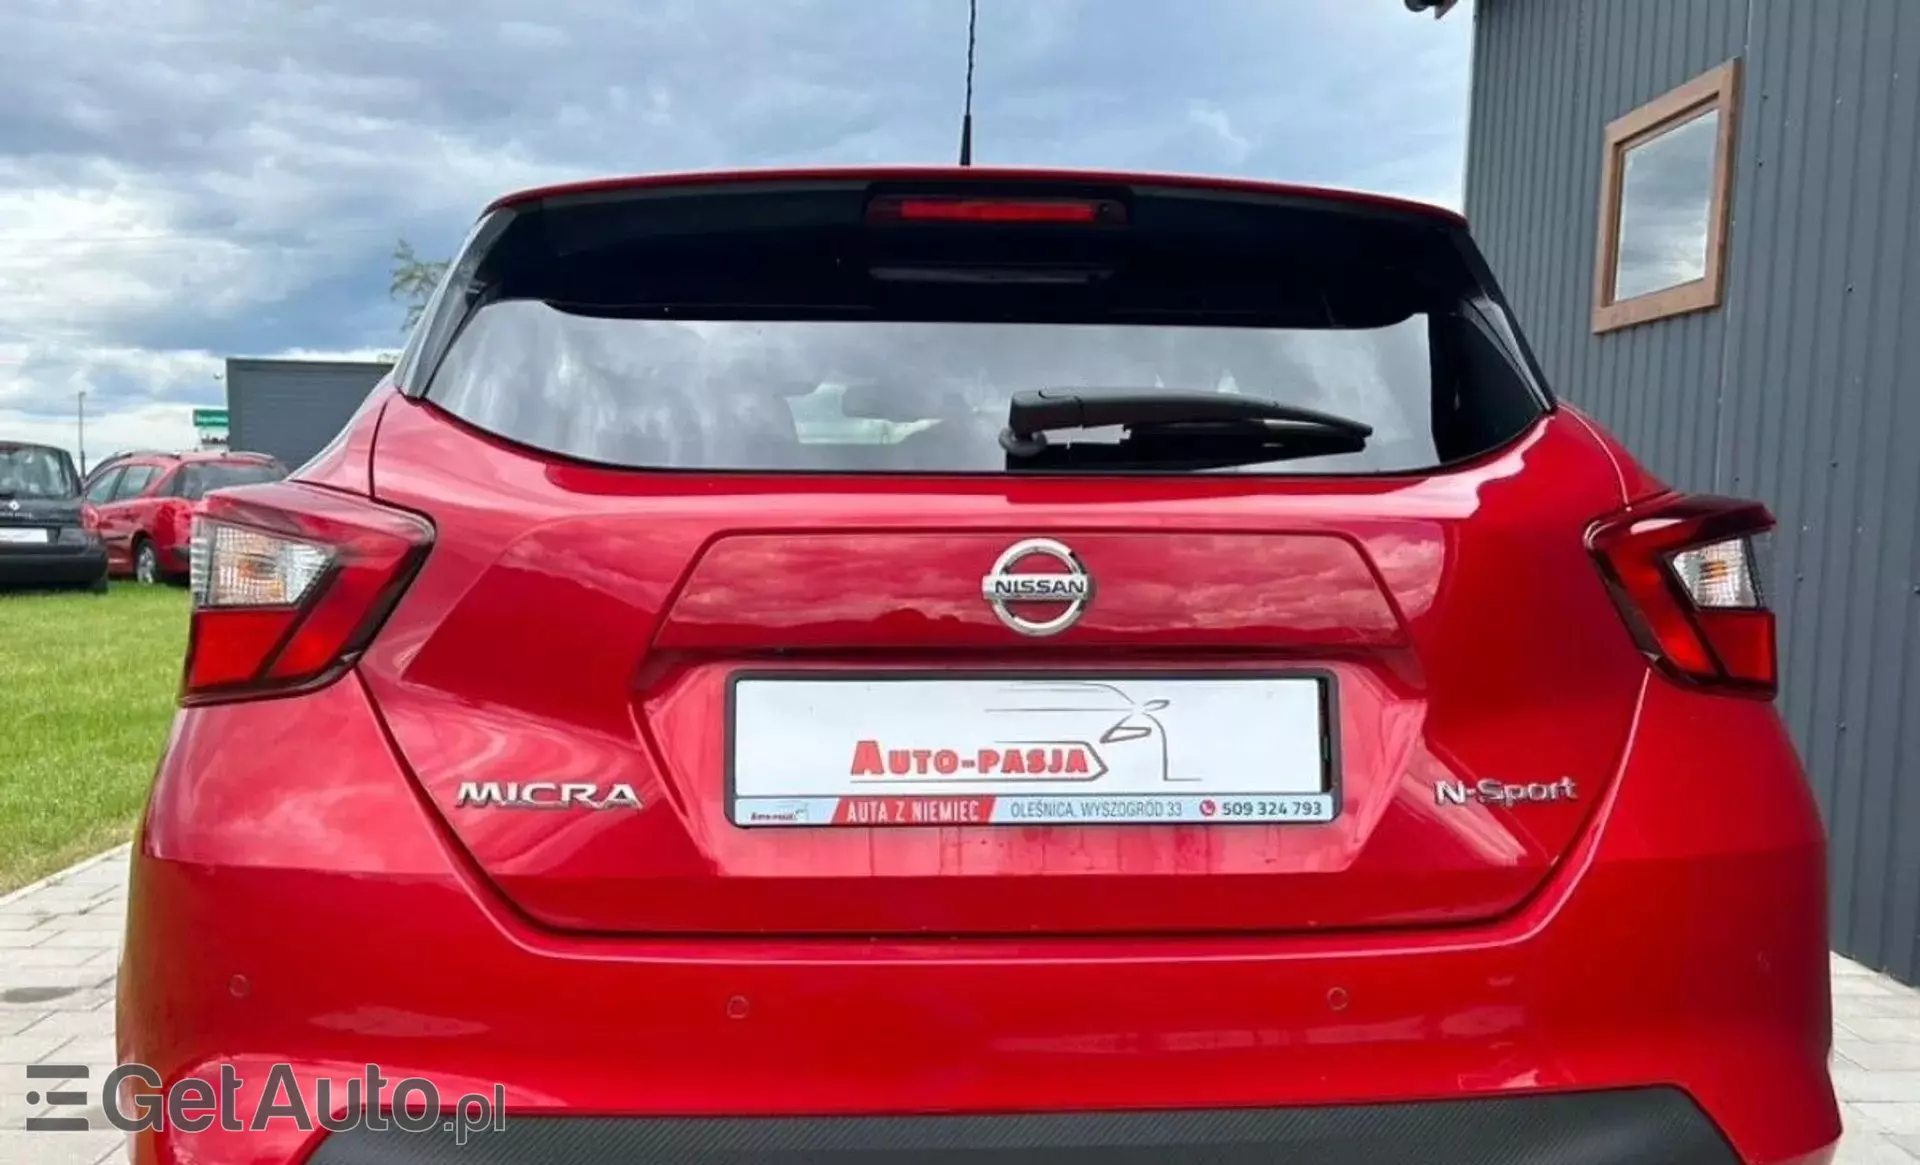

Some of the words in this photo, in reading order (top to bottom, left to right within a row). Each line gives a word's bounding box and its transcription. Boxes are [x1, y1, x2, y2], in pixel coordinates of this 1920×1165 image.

[995, 580, 1084, 594] NISSAN
[455, 781, 643, 808] MICRA
[1434, 775, 1578, 807] N-Sport
[847, 802, 886, 822] AUTA
[895, 801, 905, 821] Z
[912, 800, 979, 821] NIEMIEC
[1011, 798, 1074, 819] OLEŚNICA,
[1082, 798, 1163, 818] WYSZOGRÓD
[1168, 801, 1183, 817] 33
[1222, 802, 1252, 816] 509
[1257, 802, 1287, 816] 324
[1293, 801, 1322, 816] 793
